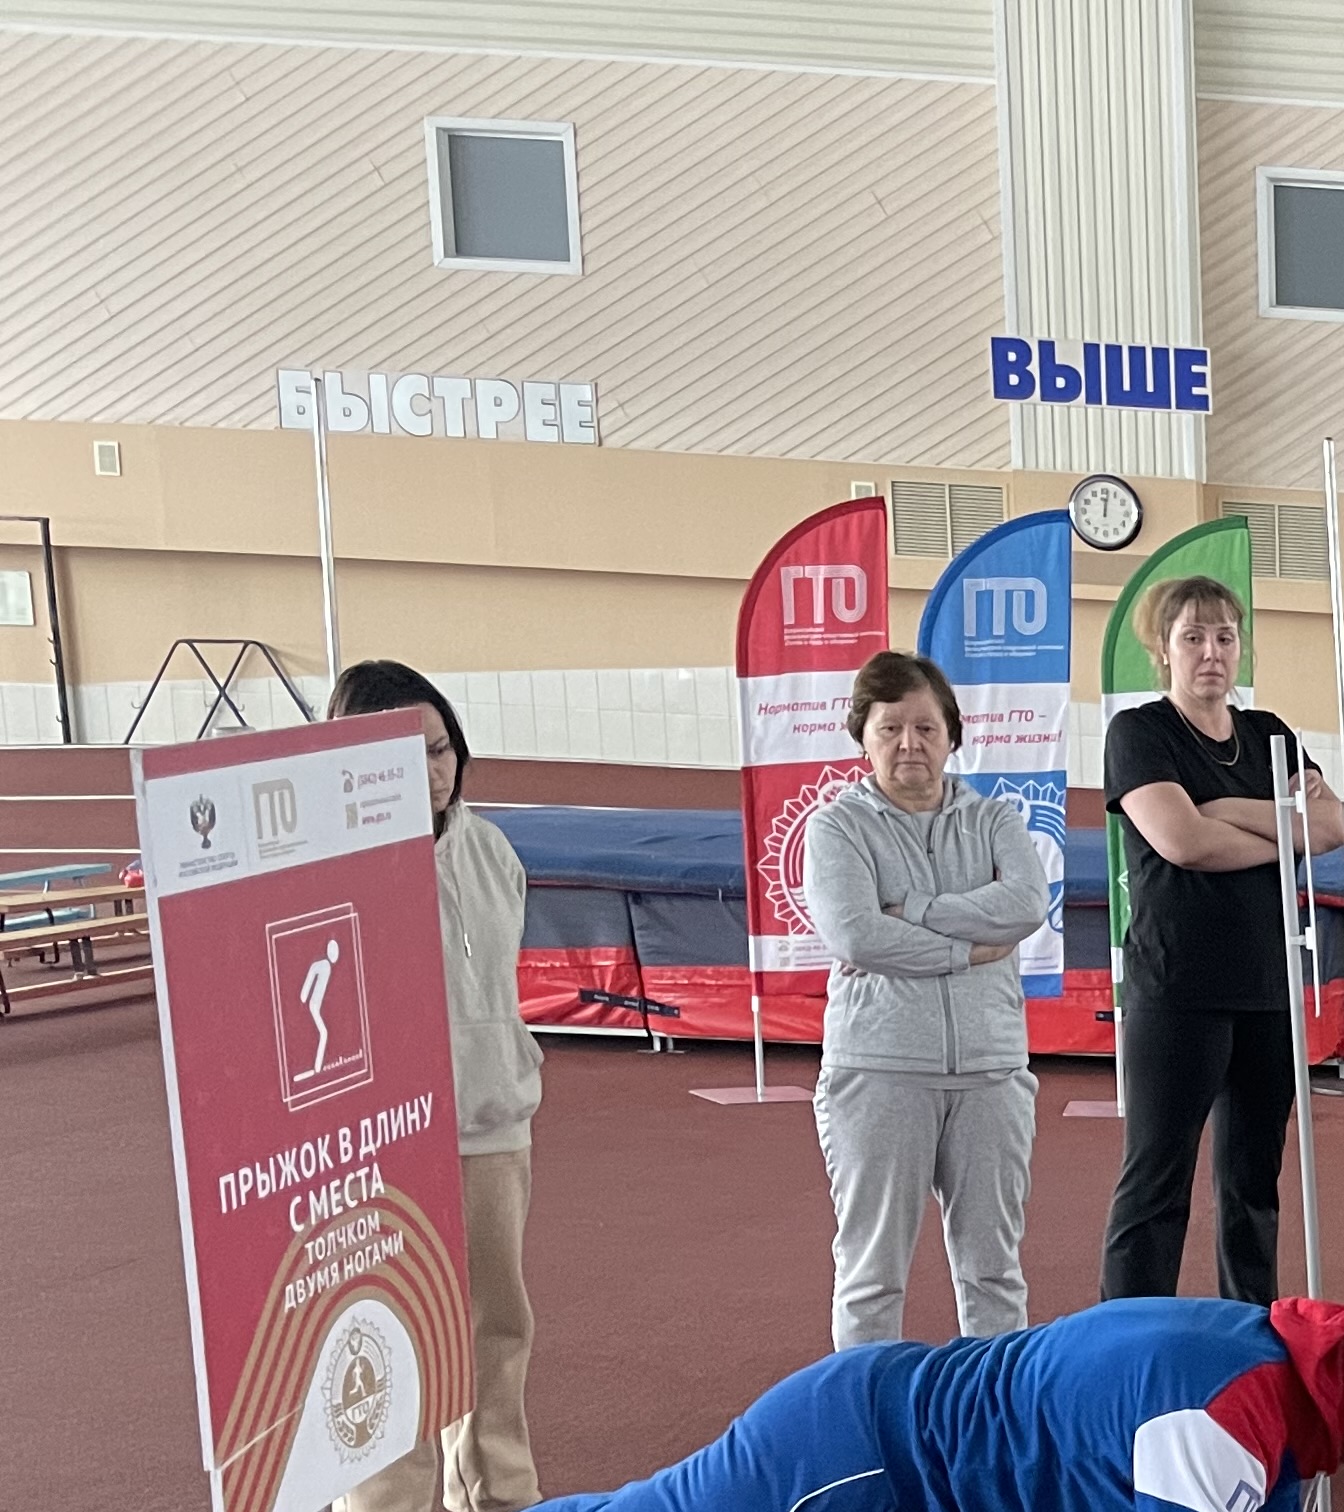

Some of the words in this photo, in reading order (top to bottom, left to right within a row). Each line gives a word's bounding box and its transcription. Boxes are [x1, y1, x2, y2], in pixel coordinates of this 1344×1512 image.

[991, 337, 1210, 411] ВЫШЕ
[277, 368, 597, 445] БЫСТРЕЕ
[780, 564, 867, 625] ГТО
[963, 576, 1047, 637] ГТО
[758, 700, 827, 716] Норматив
[793, 722, 836, 736] норма
[961, 712, 1004, 725] матив
[1008, 709, 1035, 723] ГТО
[972, 733, 1011, 747] норма
[252, 777, 298, 840] ГТО
[219, 1134, 334, 1214] ПРЫЖОК
[338, 1126, 353, 1164] В
[359, 1092, 433, 1162] ДЛИНУ
[289, 1195, 305, 1232] С
[309, 1162, 385, 1226] МЕСТА
[304, 1211, 380, 1265] ТОЛЧКОМ
[284, 1264, 340, 1313] ДВУМЯ
[343, 1230, 404, 1280] НОГАМИ
